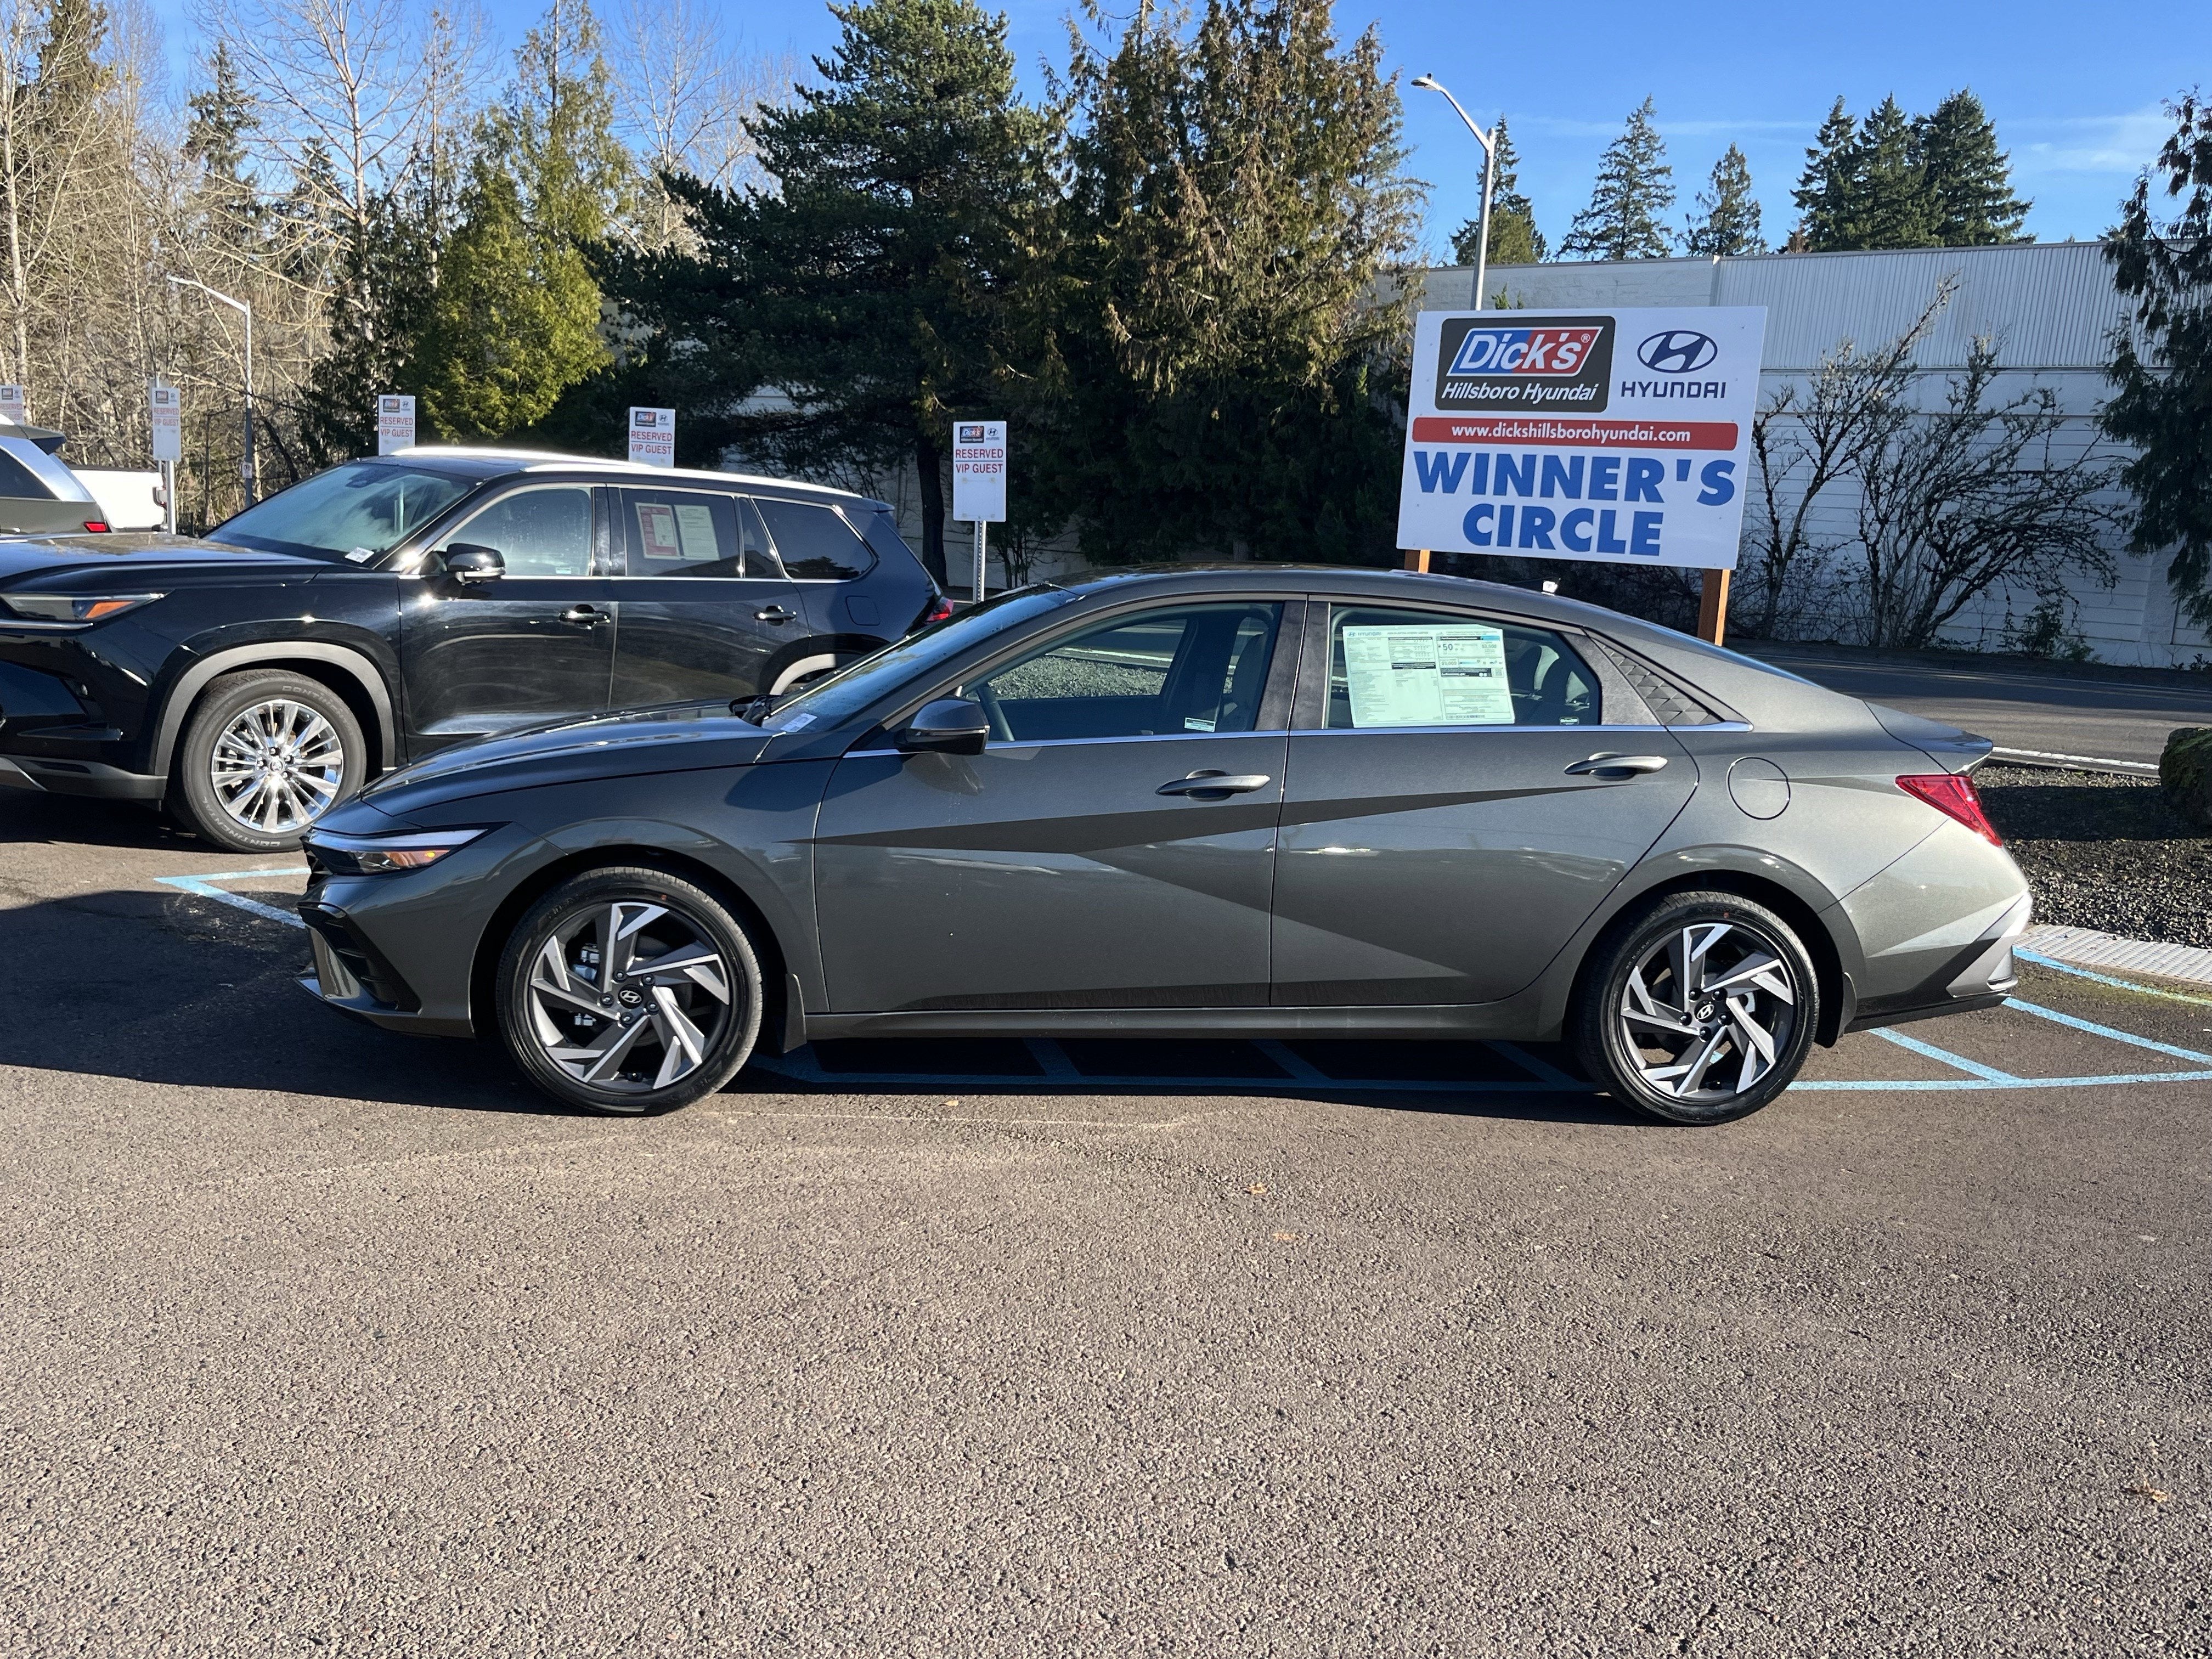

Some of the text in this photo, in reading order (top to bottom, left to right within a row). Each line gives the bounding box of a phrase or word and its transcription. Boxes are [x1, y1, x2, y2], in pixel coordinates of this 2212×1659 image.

[1459, 332, 1581, 370] Dick's
[1441, 382, 1599, 404] Hillsboro Hyundai
[1622, 381, 1726, 398] HYUNDAI
[380, 416, 414, 425] RESERVED
[392, 429, 413, 437] GUEST
[631, 431, 673, 442] RESERVED
[1452, 422, 1691, 443] www.dickshillsborohyundai.com
[631, 443, 672, 454] VIP GUEST
[955, 448, 1003, 459] RESERVED
[956, 463, 1003, 473] VIP GUEST
[1413, 450, 1736, 506] WINNER'S
[1463, 503, 1664, 557] CIRCLE
